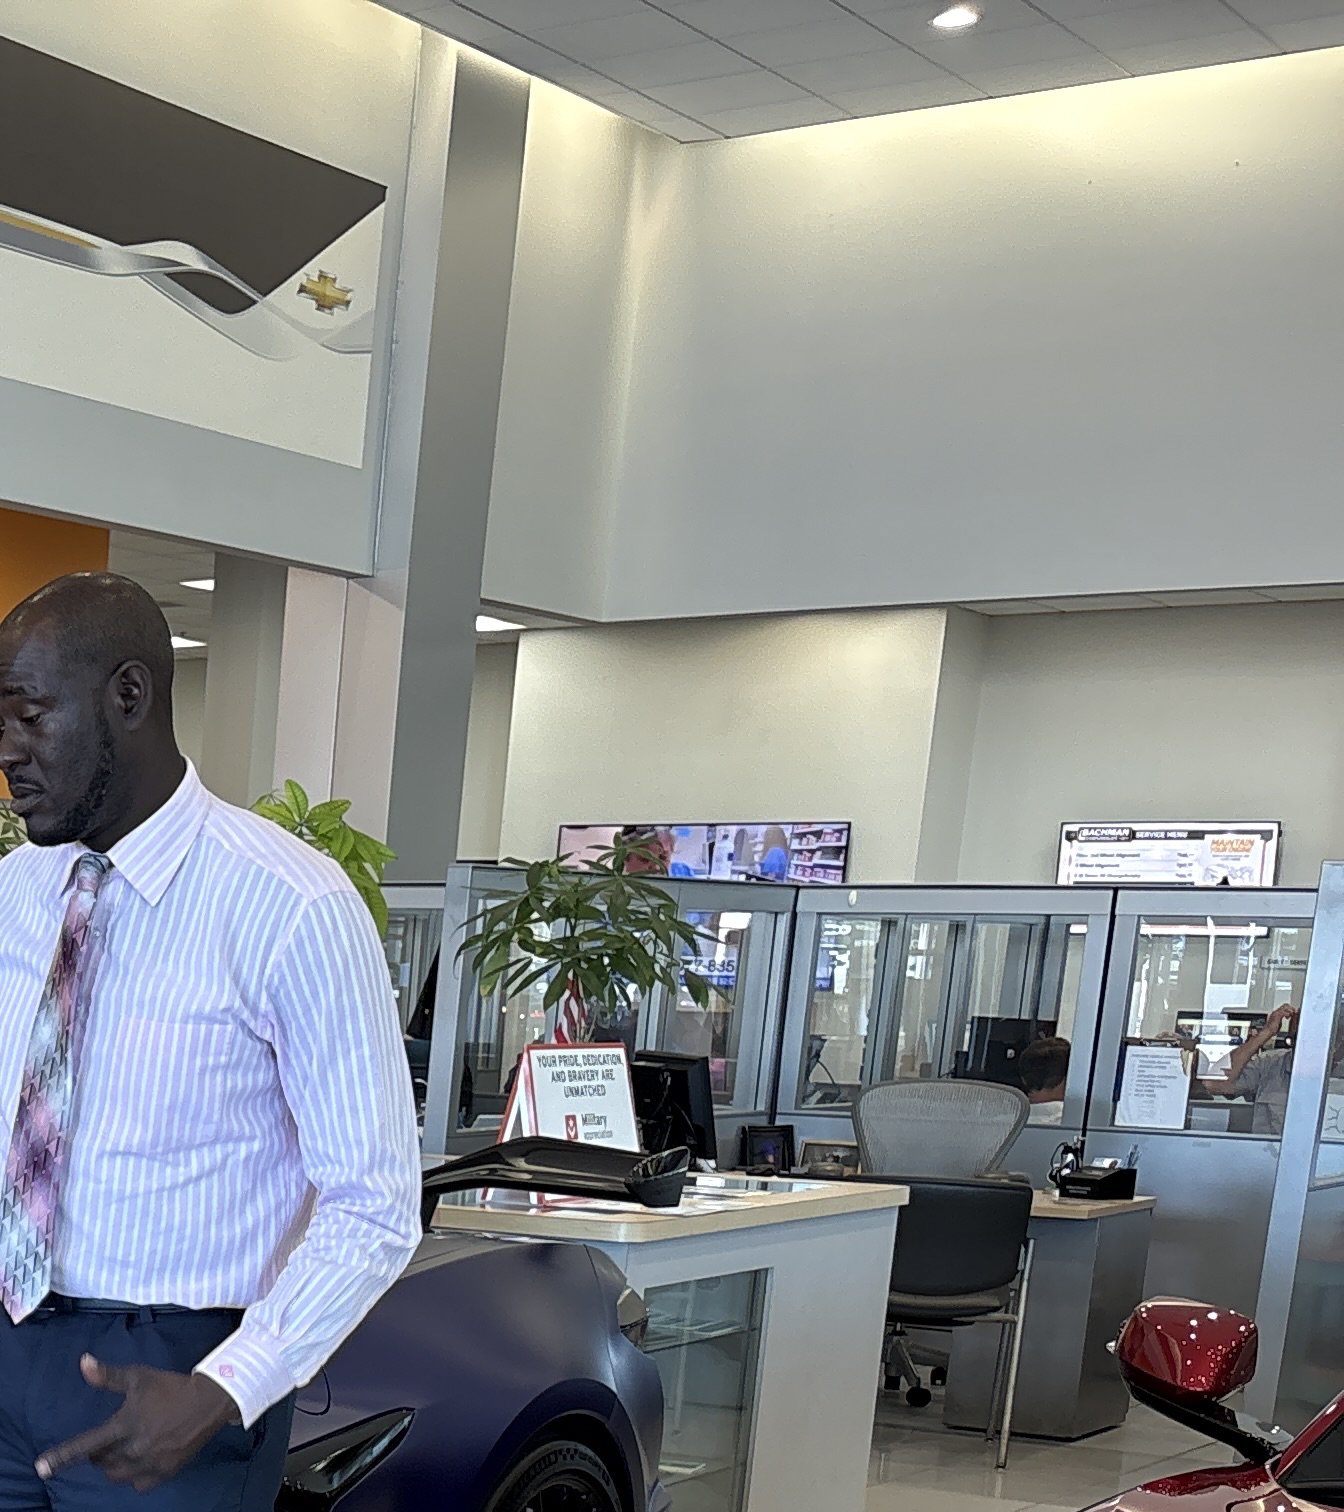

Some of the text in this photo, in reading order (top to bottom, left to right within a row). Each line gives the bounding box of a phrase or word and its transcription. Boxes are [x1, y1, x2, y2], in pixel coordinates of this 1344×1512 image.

[537, 1053, 624, 1068] YOUR PRIDE, DEDICATION,
[551, 1068, 616, 1083] AND BRAVERY ARE
[563, 1084, 606, 1098] UNMATCHED
